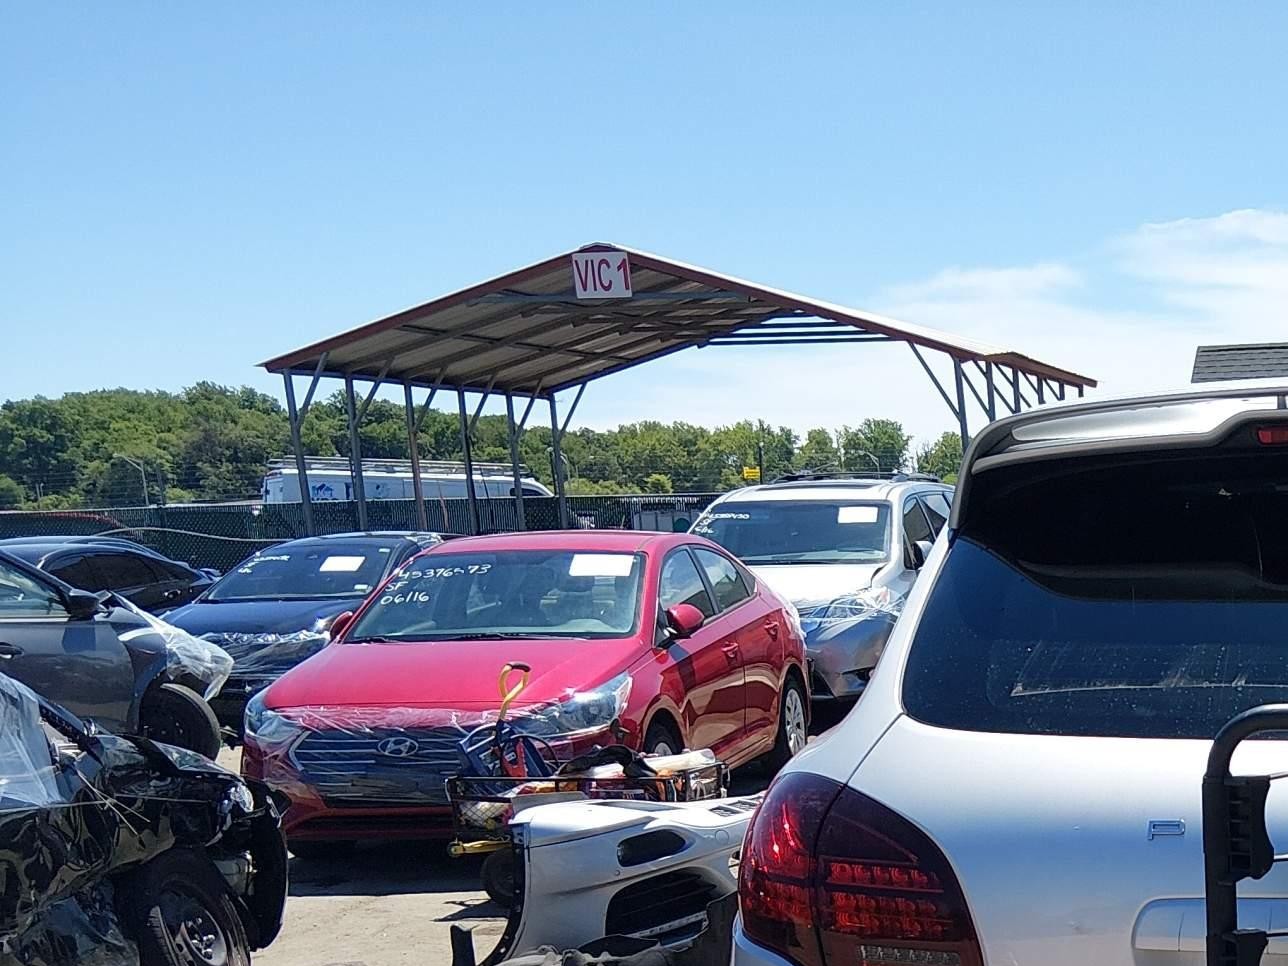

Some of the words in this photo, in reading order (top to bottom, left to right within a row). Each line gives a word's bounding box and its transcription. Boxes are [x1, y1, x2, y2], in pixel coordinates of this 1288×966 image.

[575, 258, 612, 292] VIC
[616, 257, 630, 291] 1
[385, 581, 408, 592] SF
